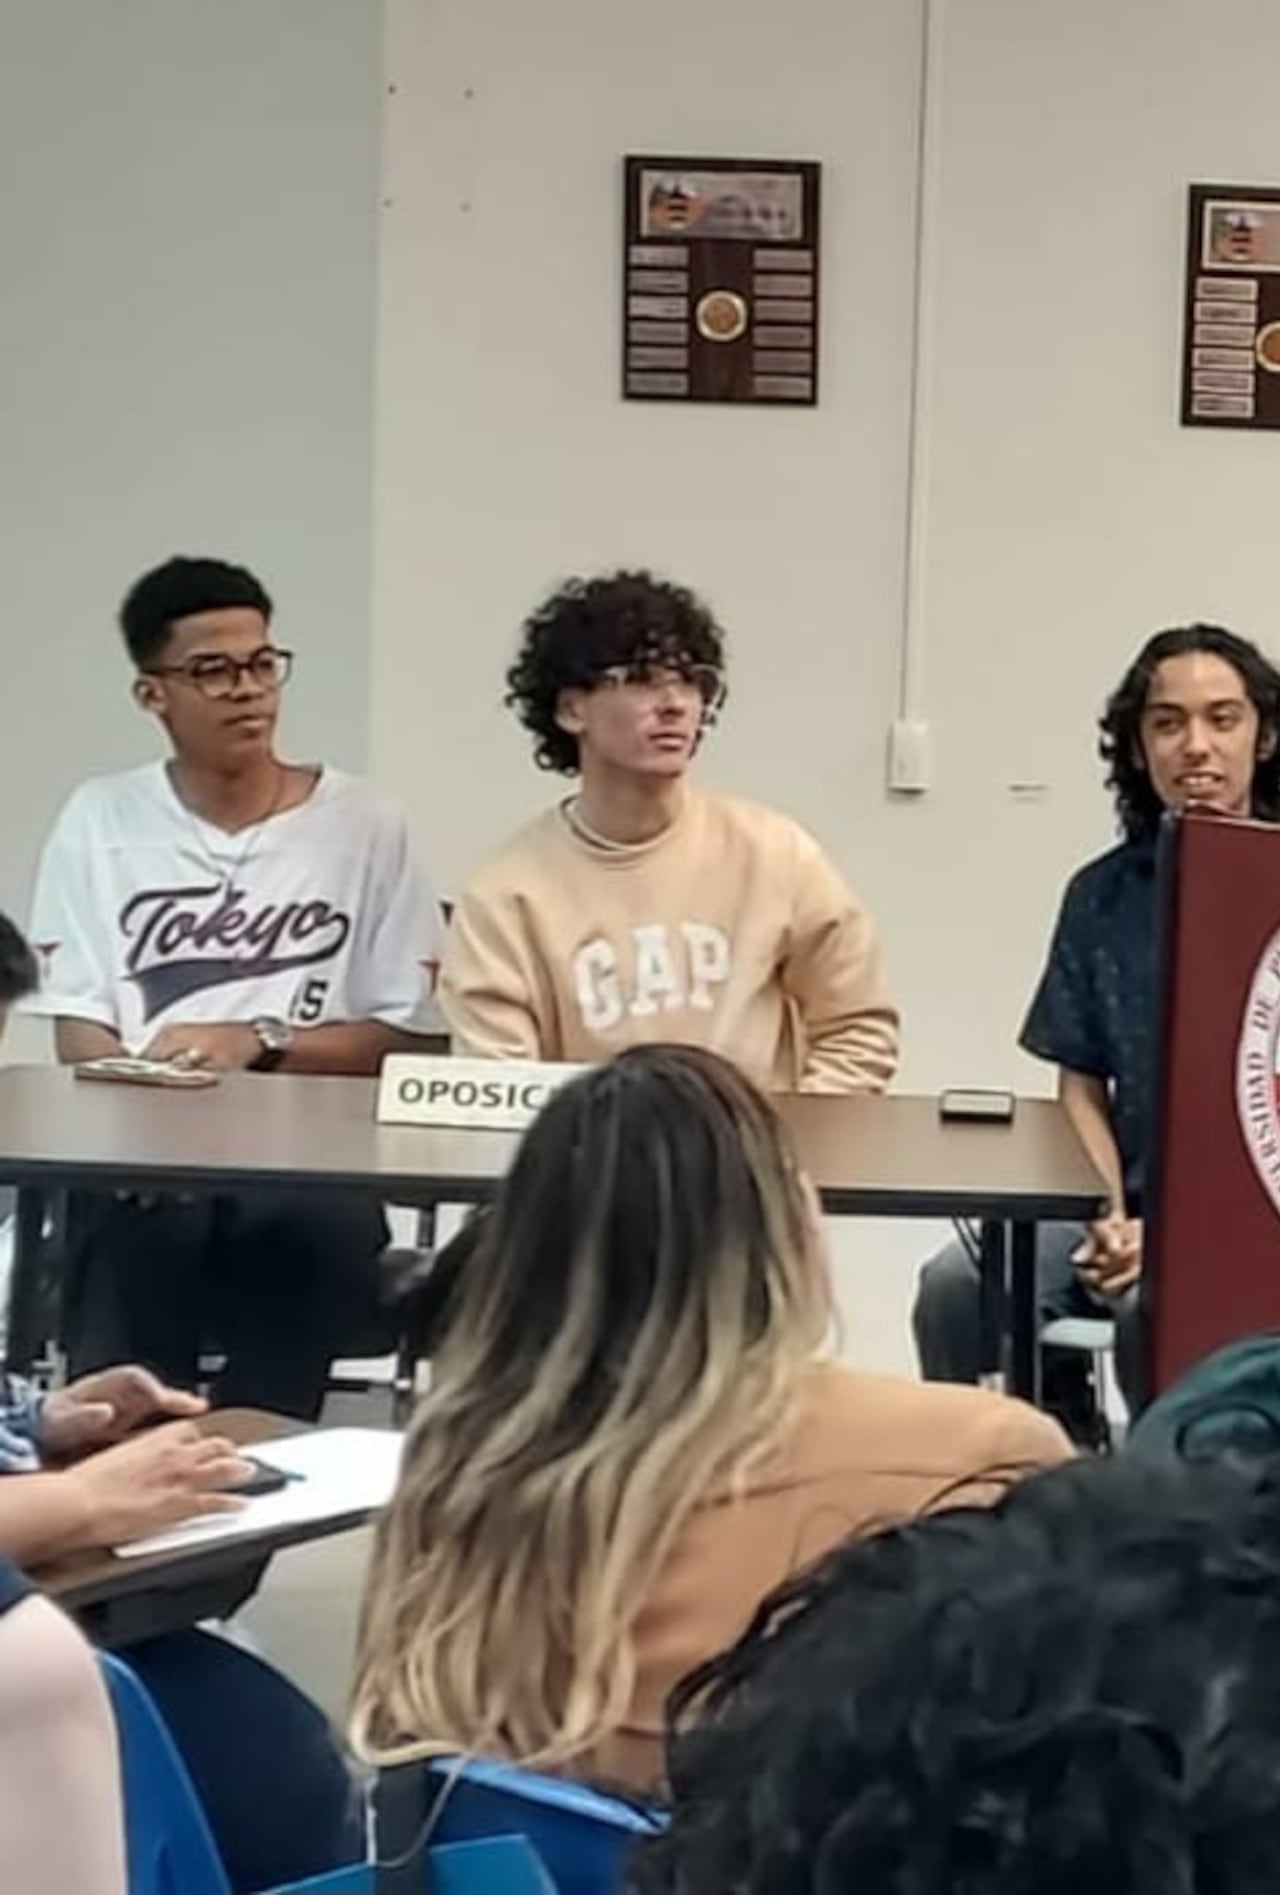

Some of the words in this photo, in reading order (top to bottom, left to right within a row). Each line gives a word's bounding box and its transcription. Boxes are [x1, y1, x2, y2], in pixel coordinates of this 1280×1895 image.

[119, 879, 350, 974] Tokyo
[574, 920, 731, 1031] GAP
[1253, 999, 1274, 1031] DE
[398, 1077, 556, 1112] OPOSIC
